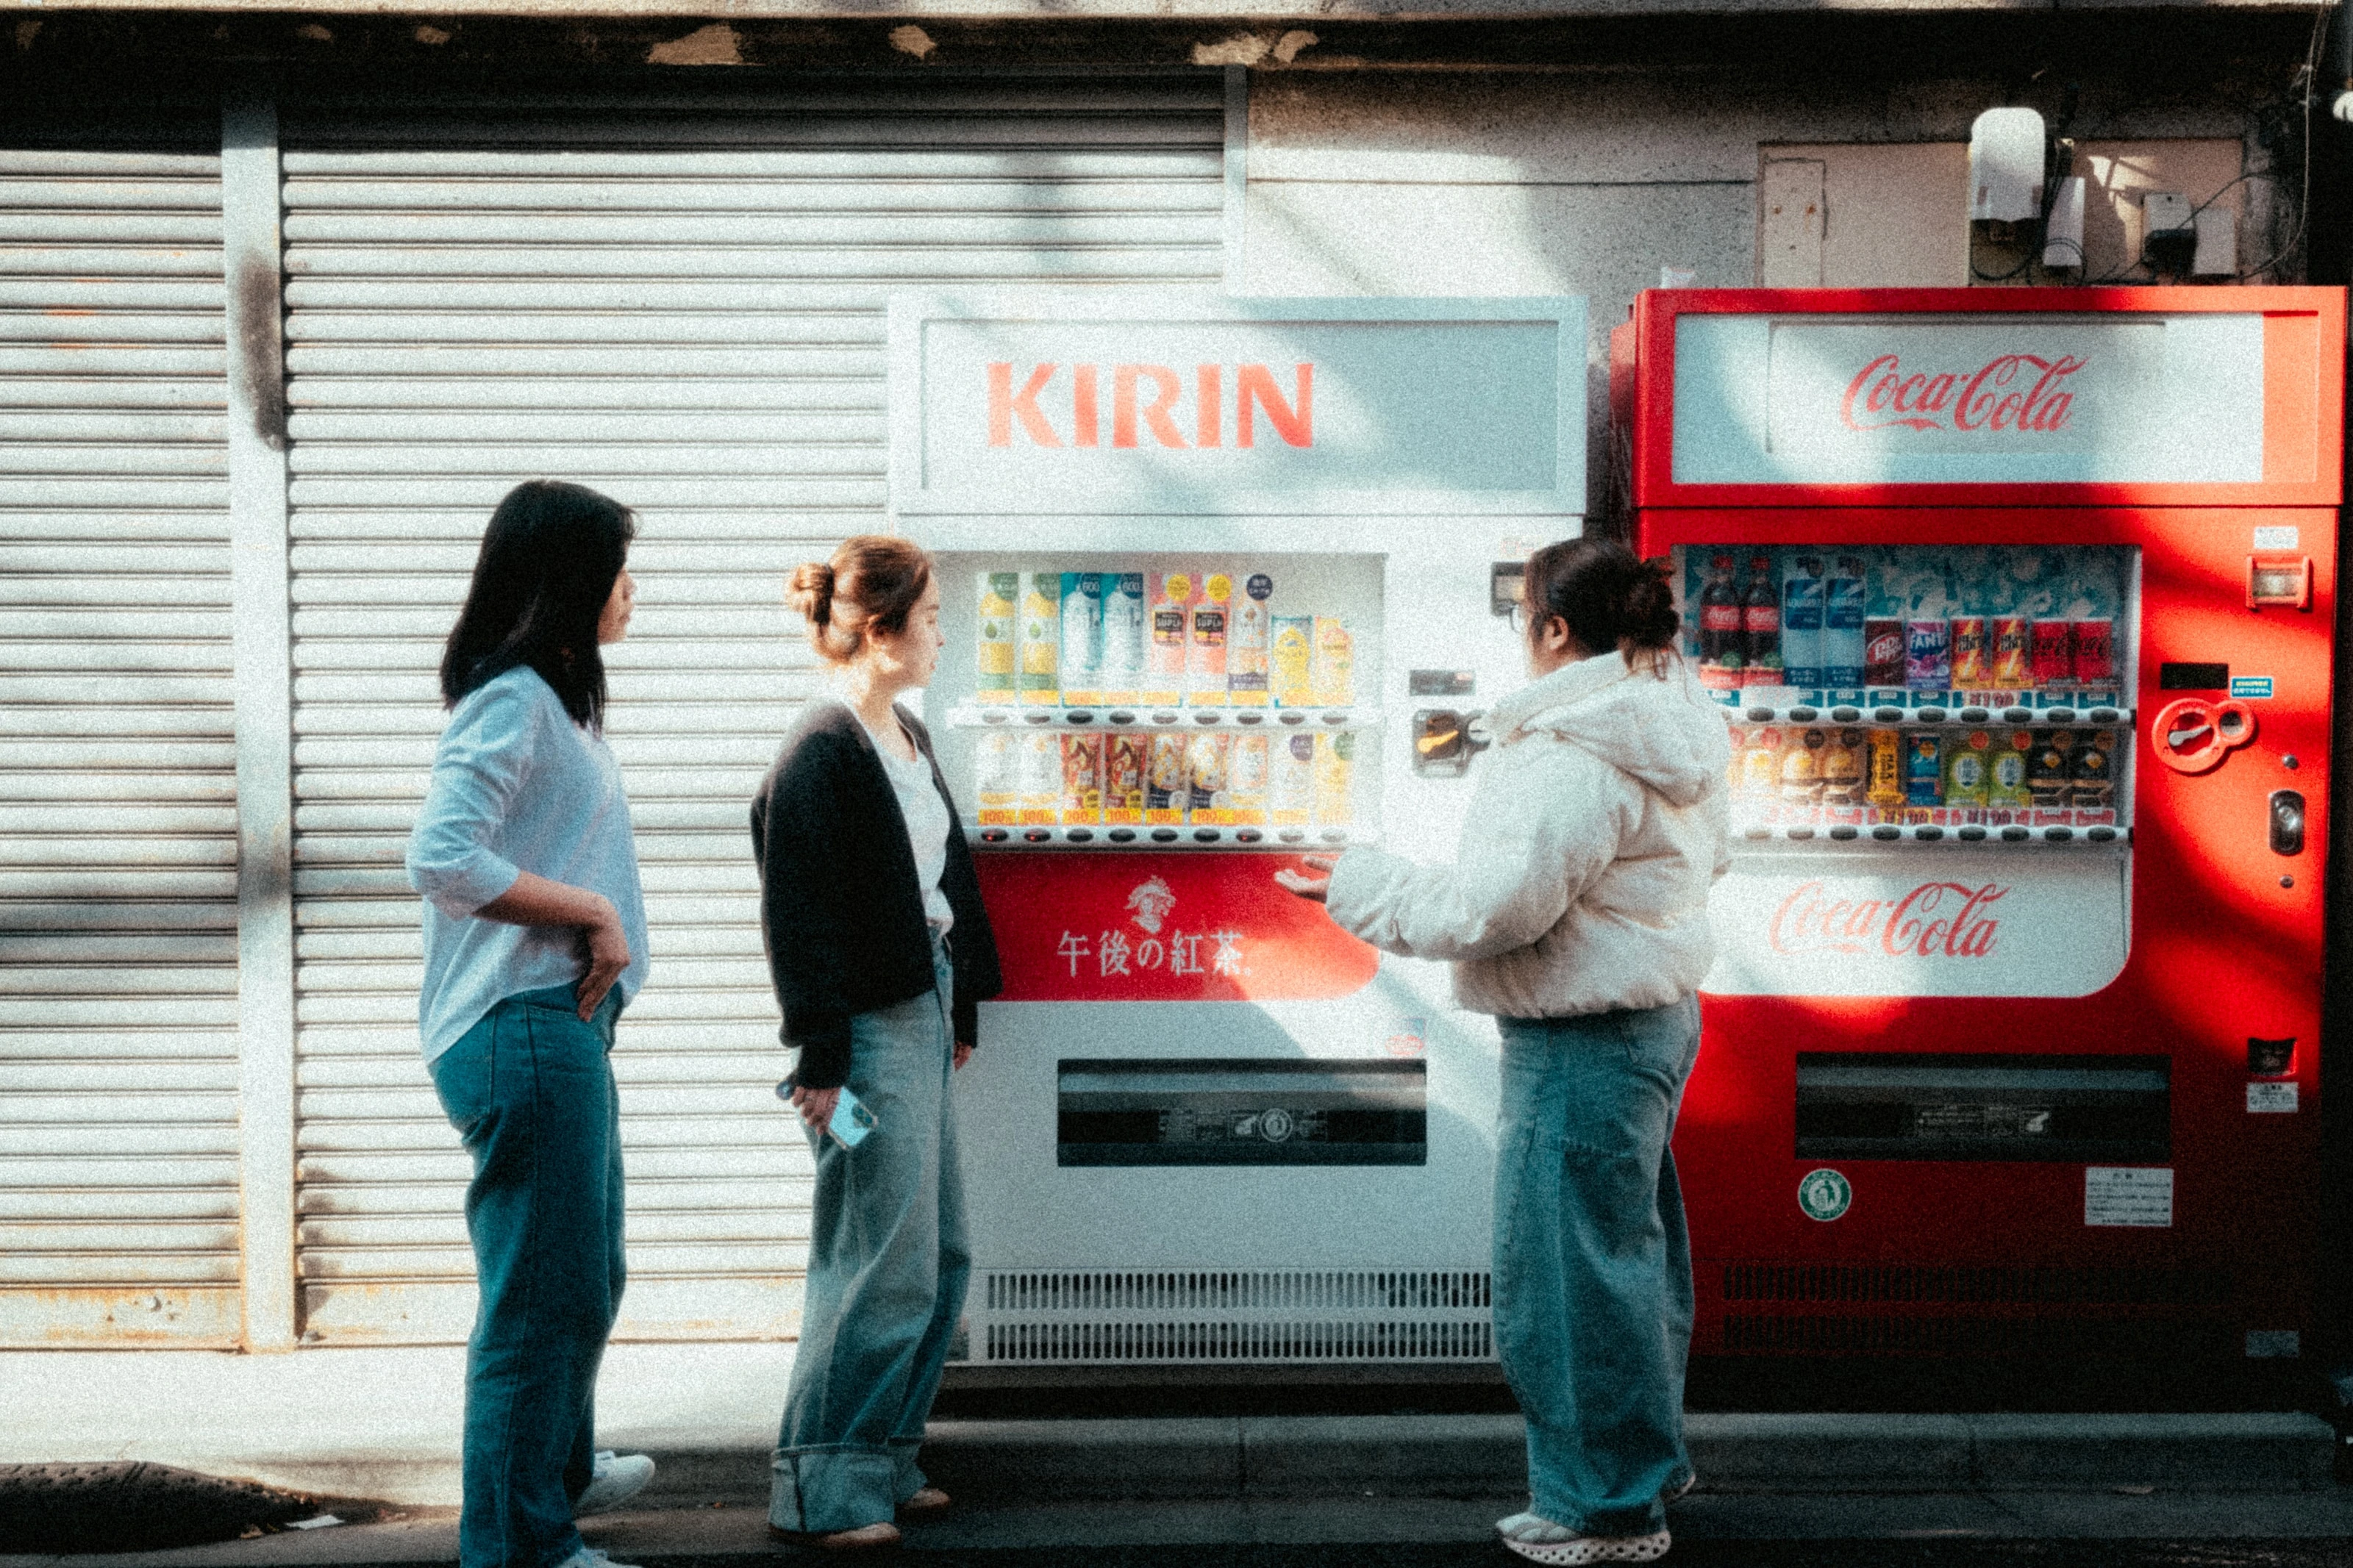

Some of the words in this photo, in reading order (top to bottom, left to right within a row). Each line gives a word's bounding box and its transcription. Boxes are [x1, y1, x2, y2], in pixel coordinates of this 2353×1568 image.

[987, 362, 1313, 448] KIRIN
[1841, 354, 2089, 432] Coca-Cola
[1058, 929, 1243, 977] 午後の紅茶
[1769, 881, 2012, 957] Coca-Cola
